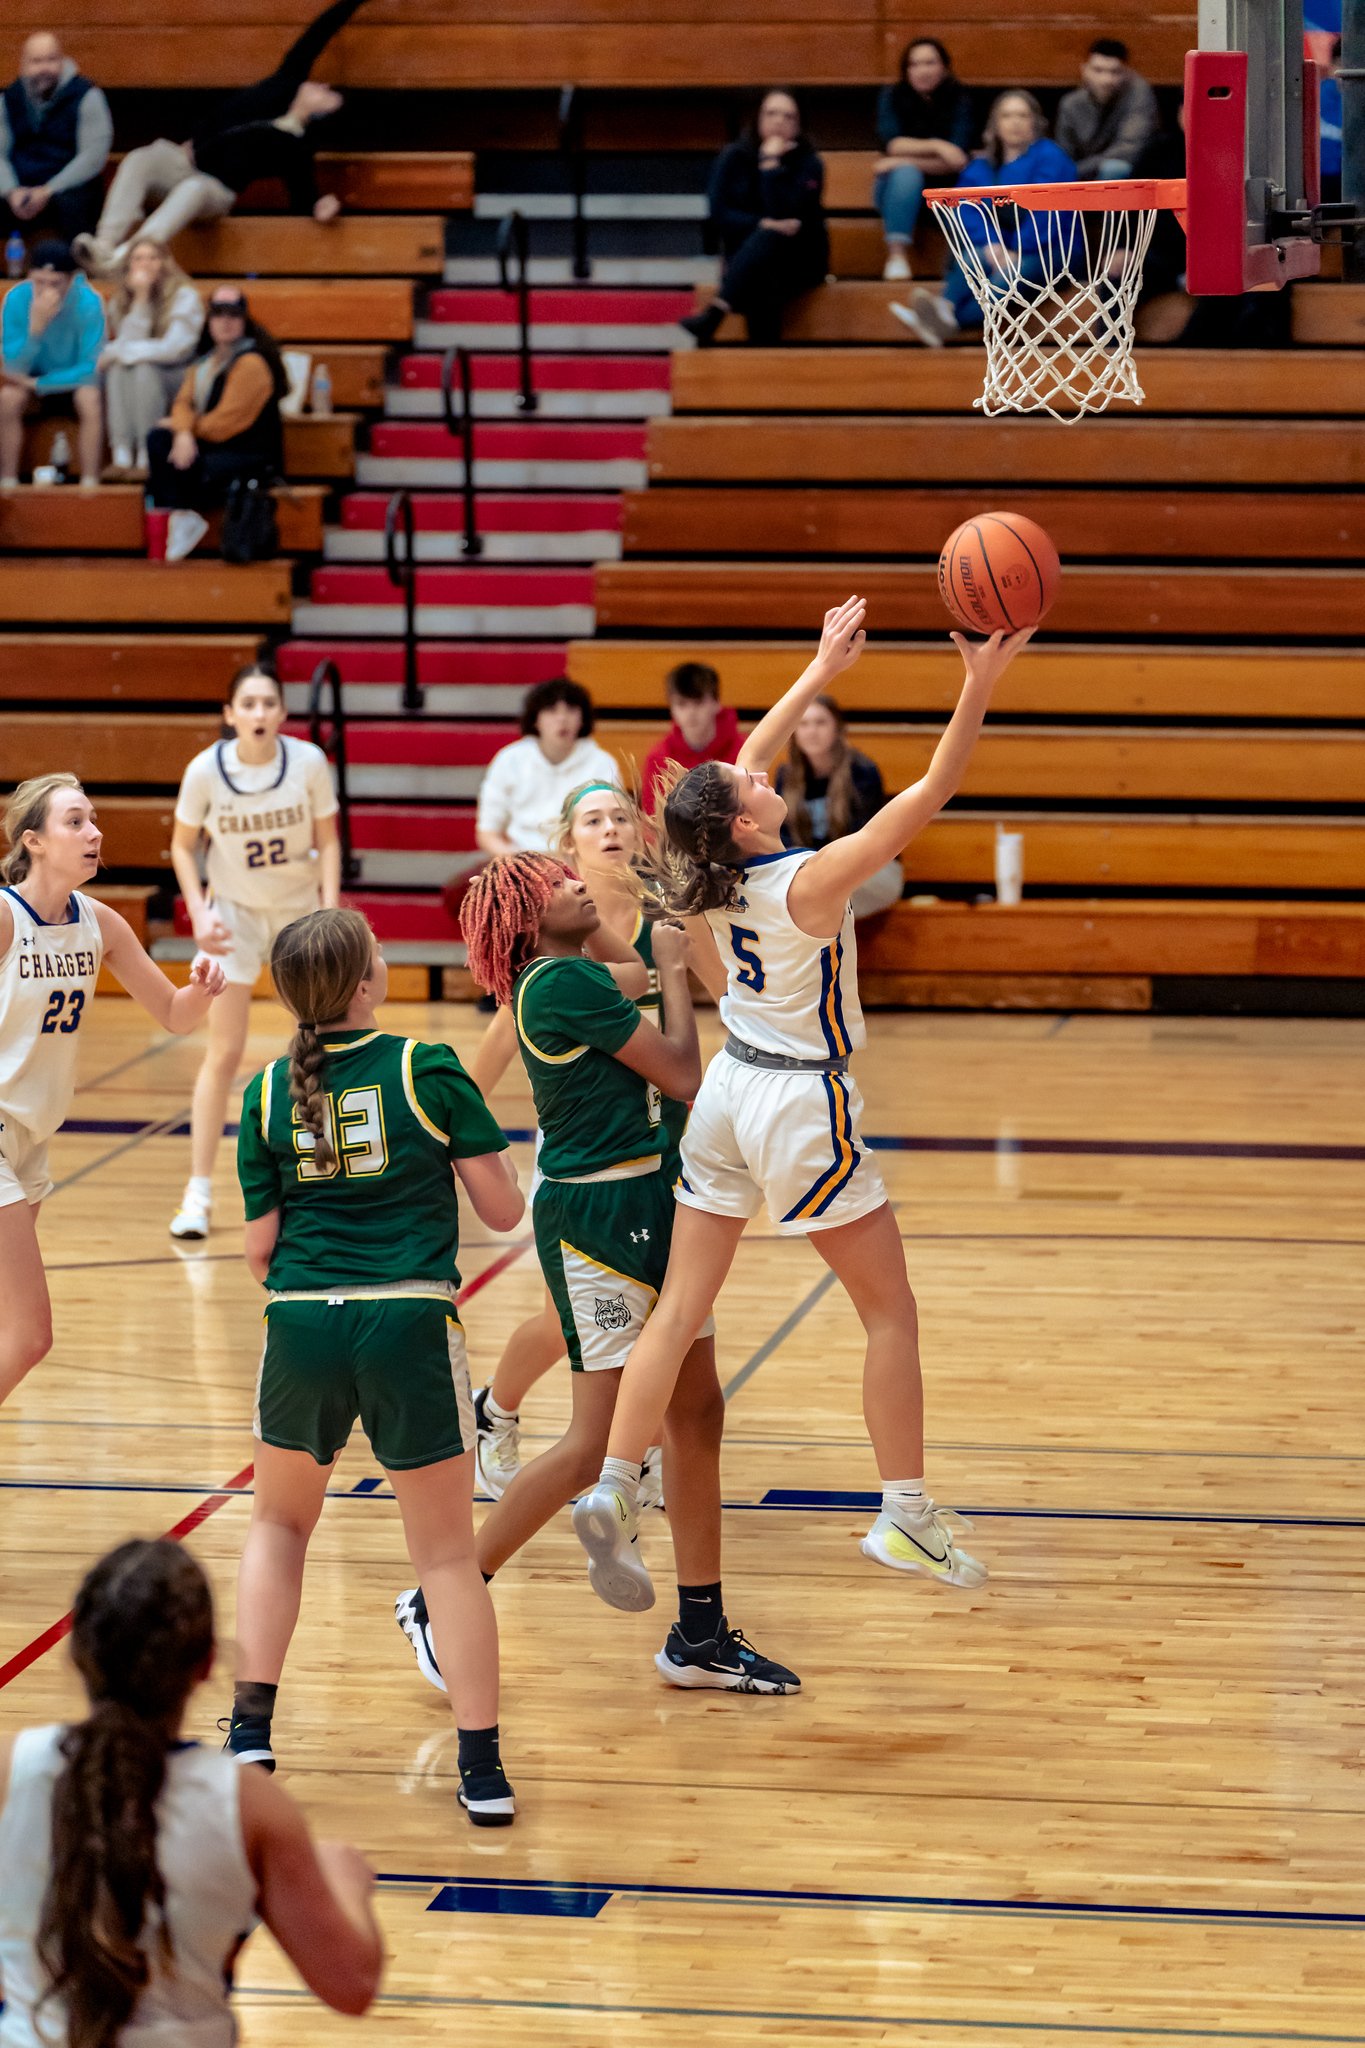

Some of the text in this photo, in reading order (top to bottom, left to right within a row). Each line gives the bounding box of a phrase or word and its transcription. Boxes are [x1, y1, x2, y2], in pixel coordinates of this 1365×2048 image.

[218, 803, 305, 834] CHARGERS
[245, 837, 290, 869] 22
[729, 922, 767, 995] 5
[40, 989, 86, 1034] 23
[291, 1084, 389, 1182] 33
